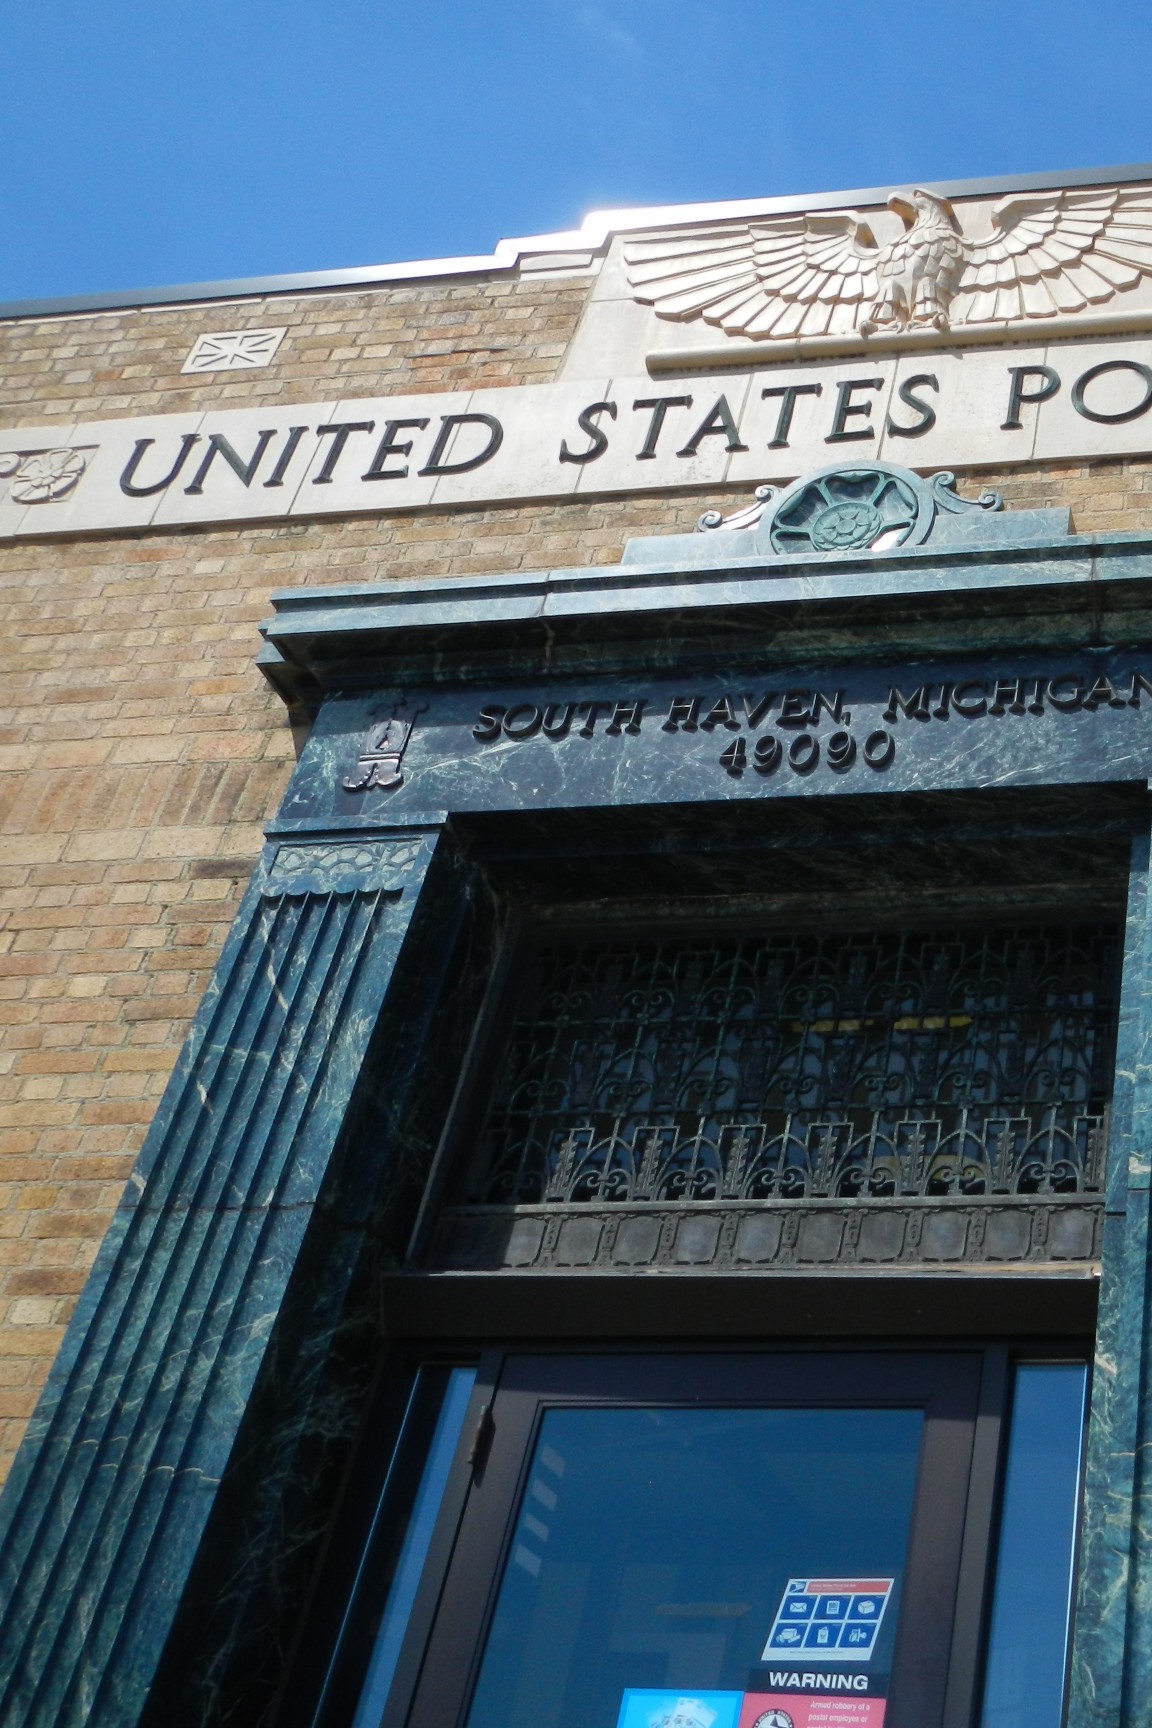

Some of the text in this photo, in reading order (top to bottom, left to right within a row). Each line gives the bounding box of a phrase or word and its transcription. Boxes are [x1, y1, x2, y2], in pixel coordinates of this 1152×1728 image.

[119, 412, 503, 497] UNITED
[559, 373, 940, 464] STATES
[473, 699, 646, 742] SOUTH
[661, 689, 852, 734] HAVEN,
[719, 730, 896, 777] 49090
[769, 1671, 868, 1690] WARNING
